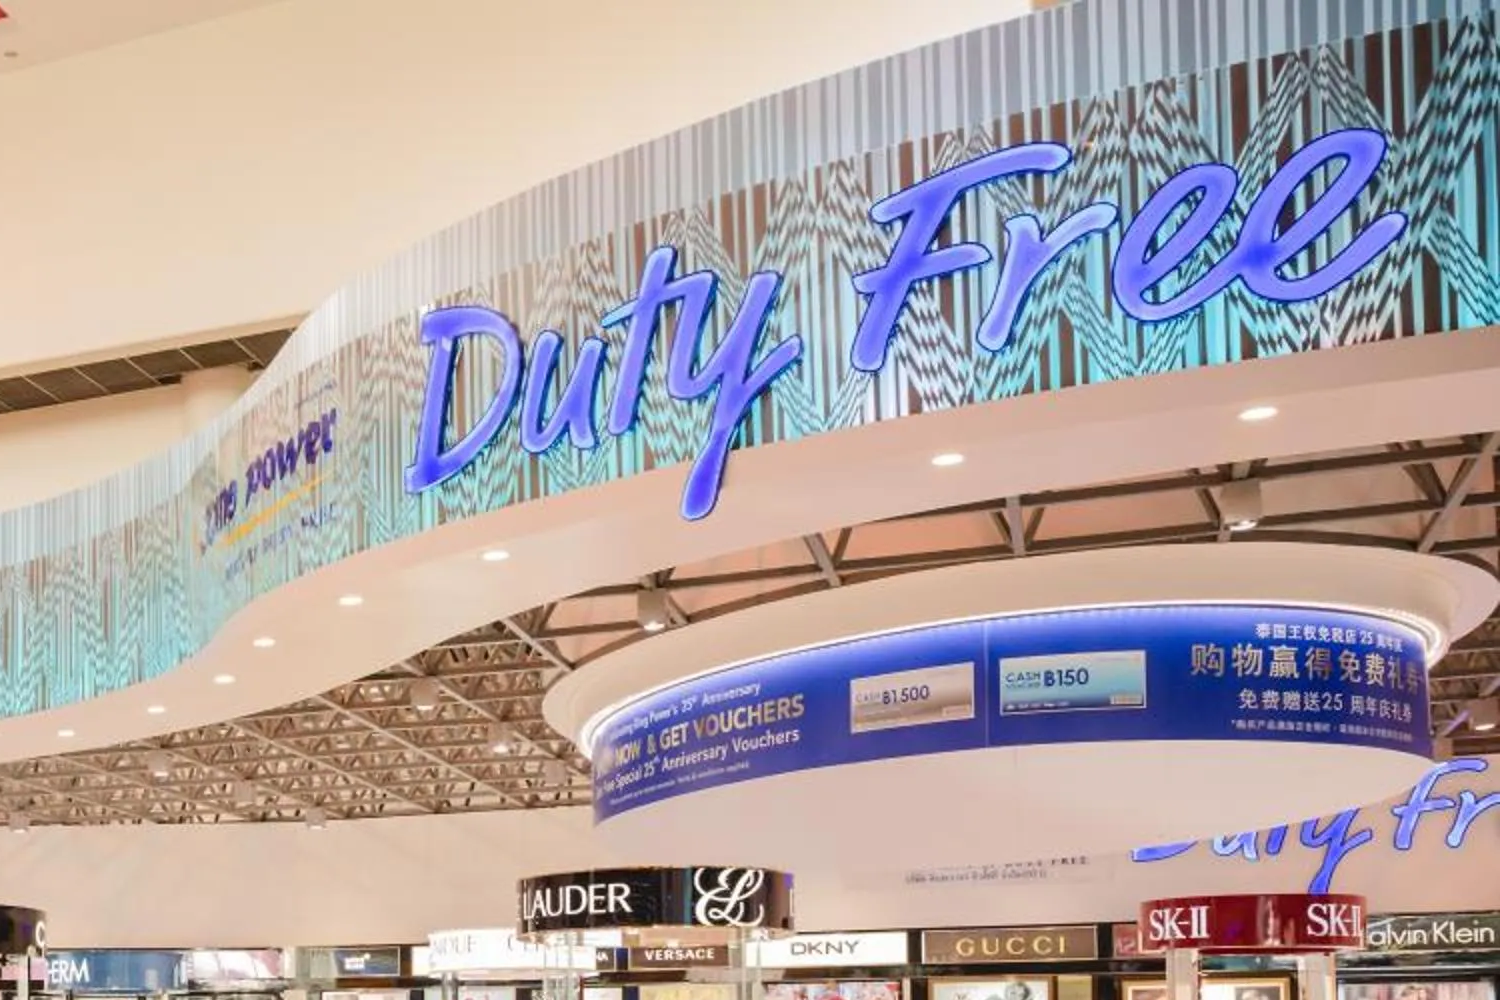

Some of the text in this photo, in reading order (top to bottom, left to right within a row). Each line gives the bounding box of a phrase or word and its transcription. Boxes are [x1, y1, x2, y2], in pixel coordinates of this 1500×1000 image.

[404, 127, 1408, 521] Duty Free
[659, 722, 690, 751] GET
[693, 693, 805, 739] VOUCHERS
[661, 743, 728, 772] Anniversary
[731, 728, 800, 754] Vouchers
[522, 883, 634, 920] LAUDER
[1148, 904, 1212, 941] SK-II
[1368, 919, 1495, 947] alvin Klein
[643, 947, 715, 961] VERSACE
[790, 939, 861, 957] DKNY
[955, 935, 1068, 957] GUCCI
